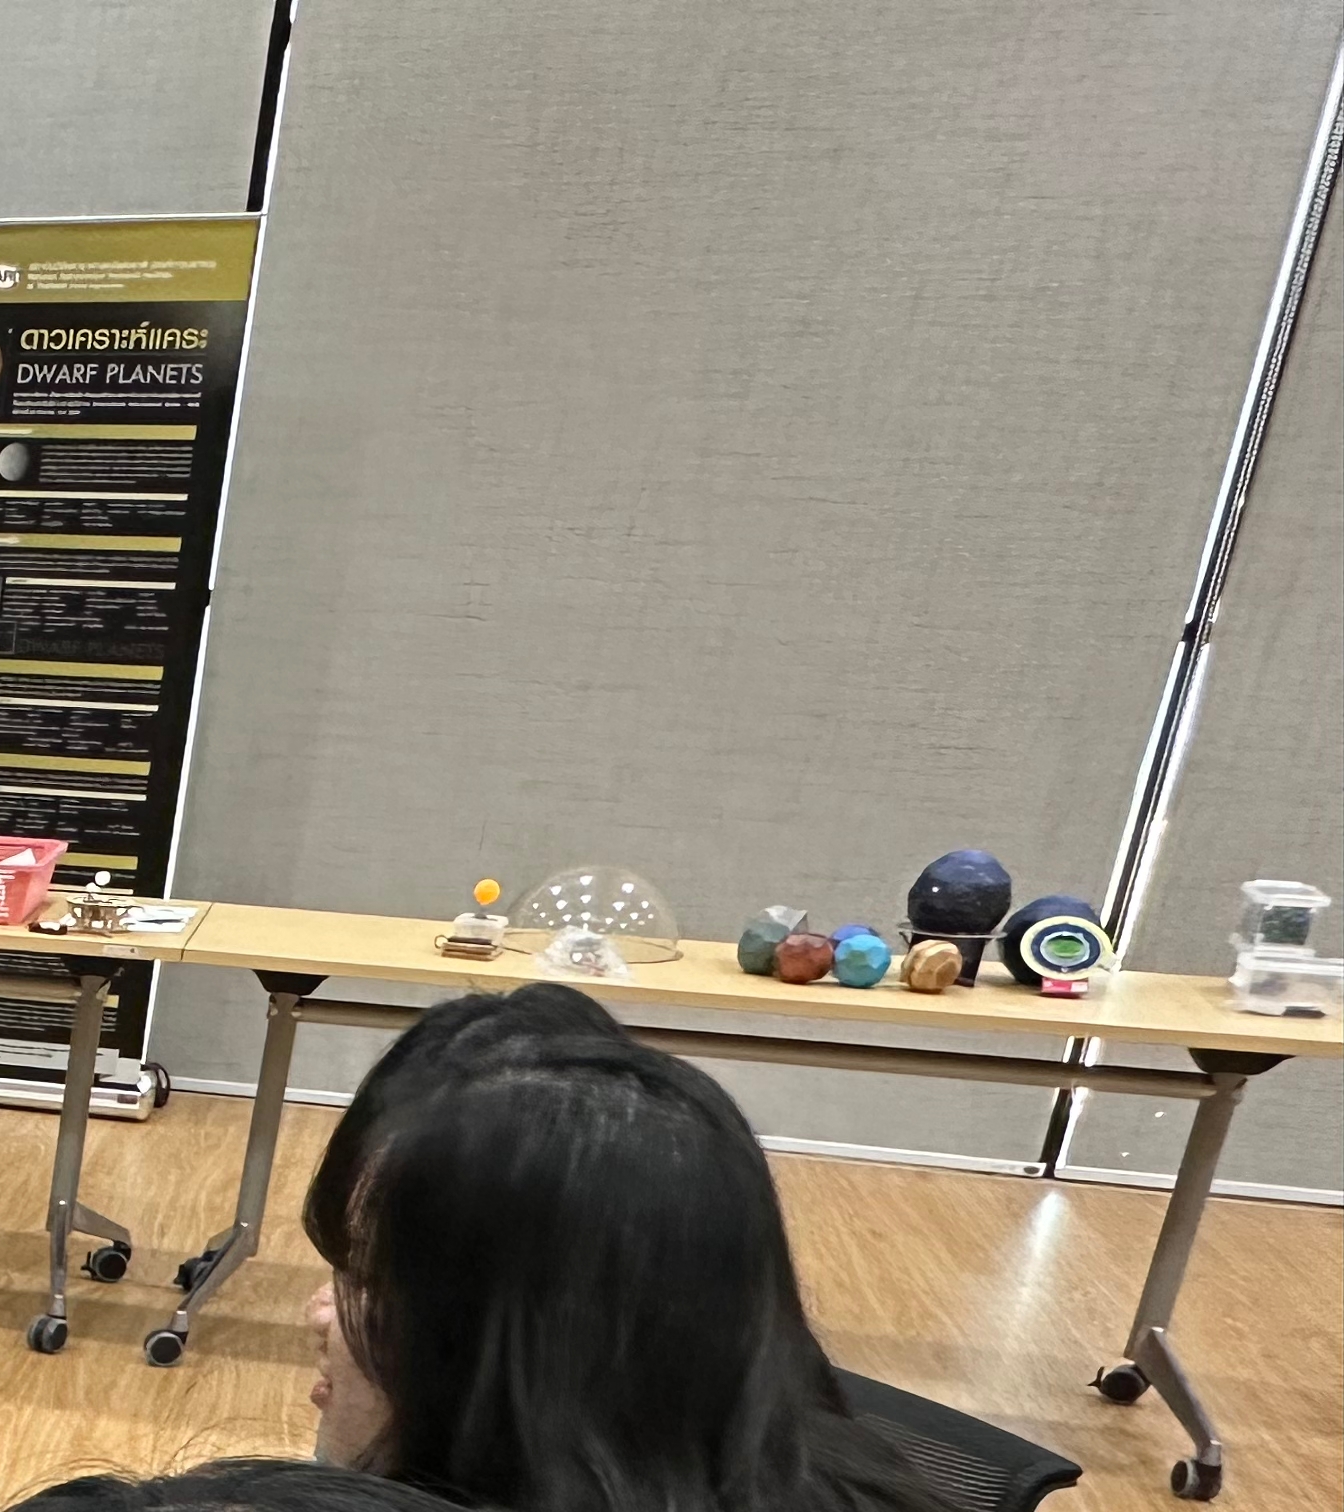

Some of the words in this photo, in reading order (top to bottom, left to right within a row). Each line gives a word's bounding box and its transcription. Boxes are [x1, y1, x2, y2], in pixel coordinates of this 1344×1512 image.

[20, 321, 209, 351] ดาวเคราะห์แคระ
[16, 363, 99, 384] DWARF
[106, 363, 204, 384] PLANETS
